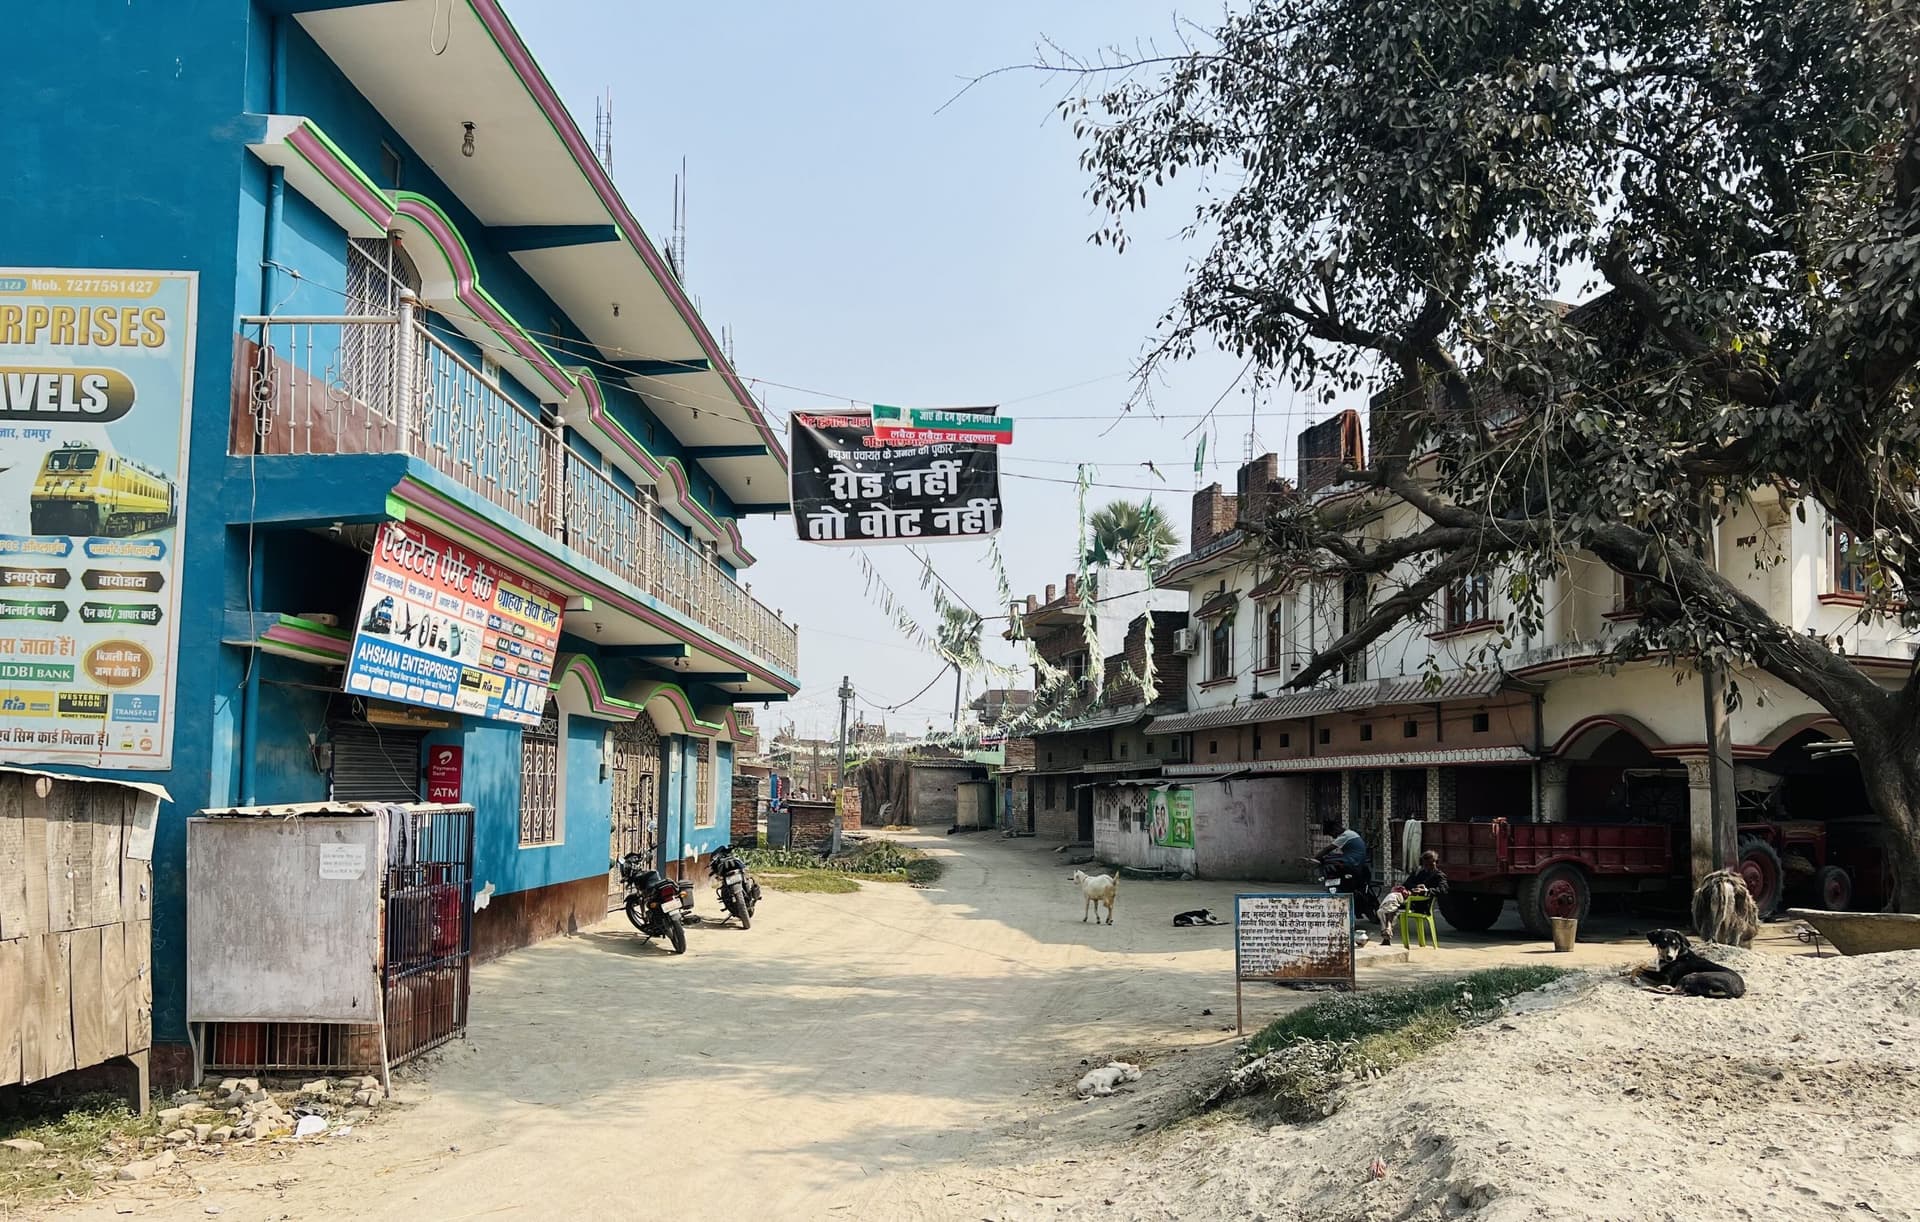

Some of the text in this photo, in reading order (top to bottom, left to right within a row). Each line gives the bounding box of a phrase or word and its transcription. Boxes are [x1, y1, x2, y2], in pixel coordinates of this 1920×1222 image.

[31, 279, 61, 291] Mob.
[23, 428, 52, 443] रामपुर
[853, 447, 881, 461] पंचायत
[882, 447, 892, 460] के
[931, 443, 953, 458] पुकार
[828, 459, 963, 500] रोड नहीं
[806, 498, 998, 540] तो वोट नहीं
[98, 574, 147, 587] बायोडाटा
[497, 588, 525, 613] ग्राहक
[525, 595, 541, 620] सेवा
[83, 606, 95, 617] पैन
[141, 608, 157, 620] कार्ड
[0, 638, 15, 655] रा
[20, 639, 56, 656] जाता
[357, 642, 402, 669] AHSHAN
[400, 653, 459, 683] ENTERPRISES
[2, 665, 71, 680] IDBI BANK
[2, 696, 25, 711] Ria
[59, 693, 100, 701] WESTERN
[115, 708, 157, 717] TRANSFAST
[14, 728, 35, 743] सिम
[37, 728, 59, 745] कार्ड
[61, 728, 94, 746] मिलता
[433, 787, 458, 798] ATM
